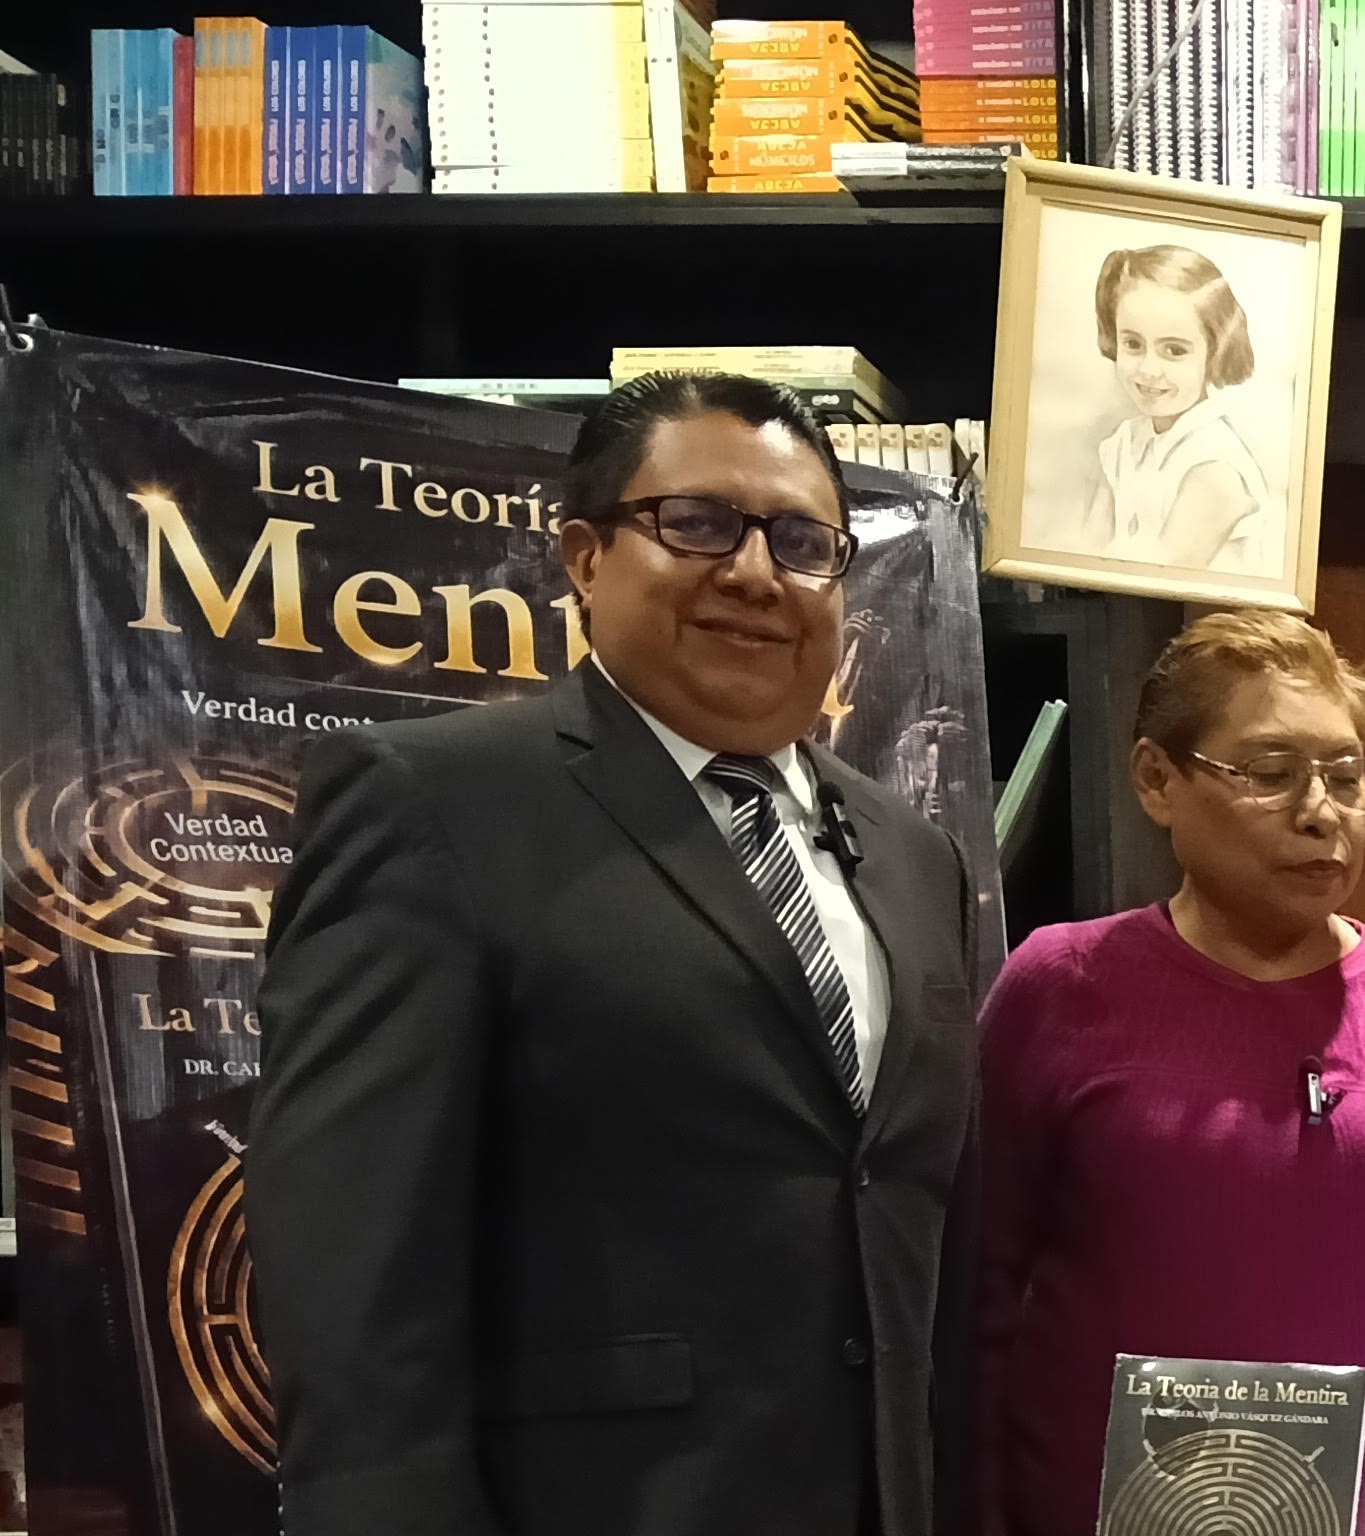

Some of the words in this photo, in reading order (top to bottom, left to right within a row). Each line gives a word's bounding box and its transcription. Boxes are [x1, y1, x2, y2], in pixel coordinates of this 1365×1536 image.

[252, 440, 341, 504] La
[181, 690, 296, 728] Verdad
[163, 811, 268, 838] Verdad
[149, 837, 294, 865] Contextua
[138, 994, 196, 1032] La
[203, 998, 263, 1035] Te
[184, 1058, 219, 1075] DR.
[1126, 1374, 1151, 1395] La
[1224, 1379, 1249, 1400] de
[1254, 1381, 1270, 1402] la
[1276, 1382, 1349, 1406] Mentira
